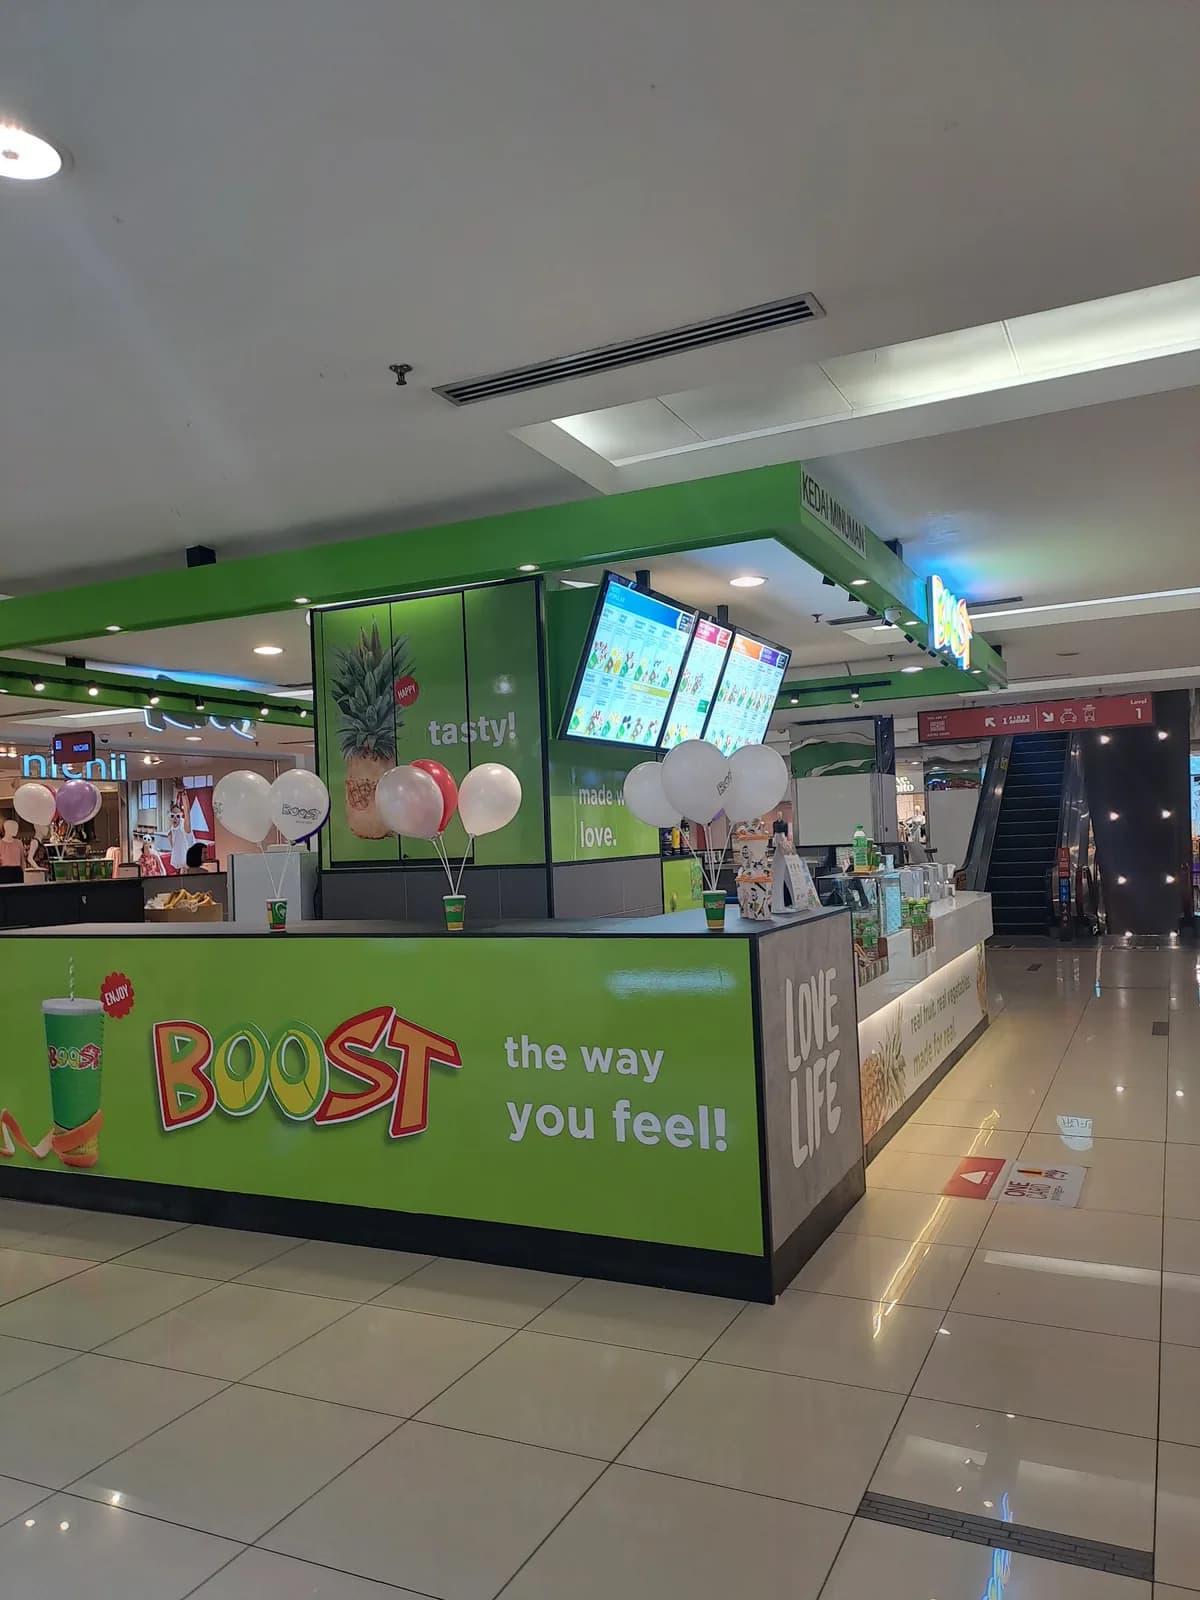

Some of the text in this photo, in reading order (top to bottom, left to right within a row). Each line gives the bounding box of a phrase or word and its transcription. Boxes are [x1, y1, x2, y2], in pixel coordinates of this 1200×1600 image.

[802, 471, 865, 553] KEDAI MINUMAN
[397, 685, 416, 700] HAPPY
[1135, 707, 1142, 720] 1
[428, 711, 517, 748] tasty!
[578, 783, 613, 806] made
[579, 820, 618, 849] love.
[104, 983, 130, 1007] ENJOY
[785, 967, 840, 1073] LOVE
[153, 1005, 464, 1139] BOOST
[504, 1034, 665, 1084] the way
[505, 1099, 728, 1152] you feel!
[790, 1048, 842, 1169] LIFE
